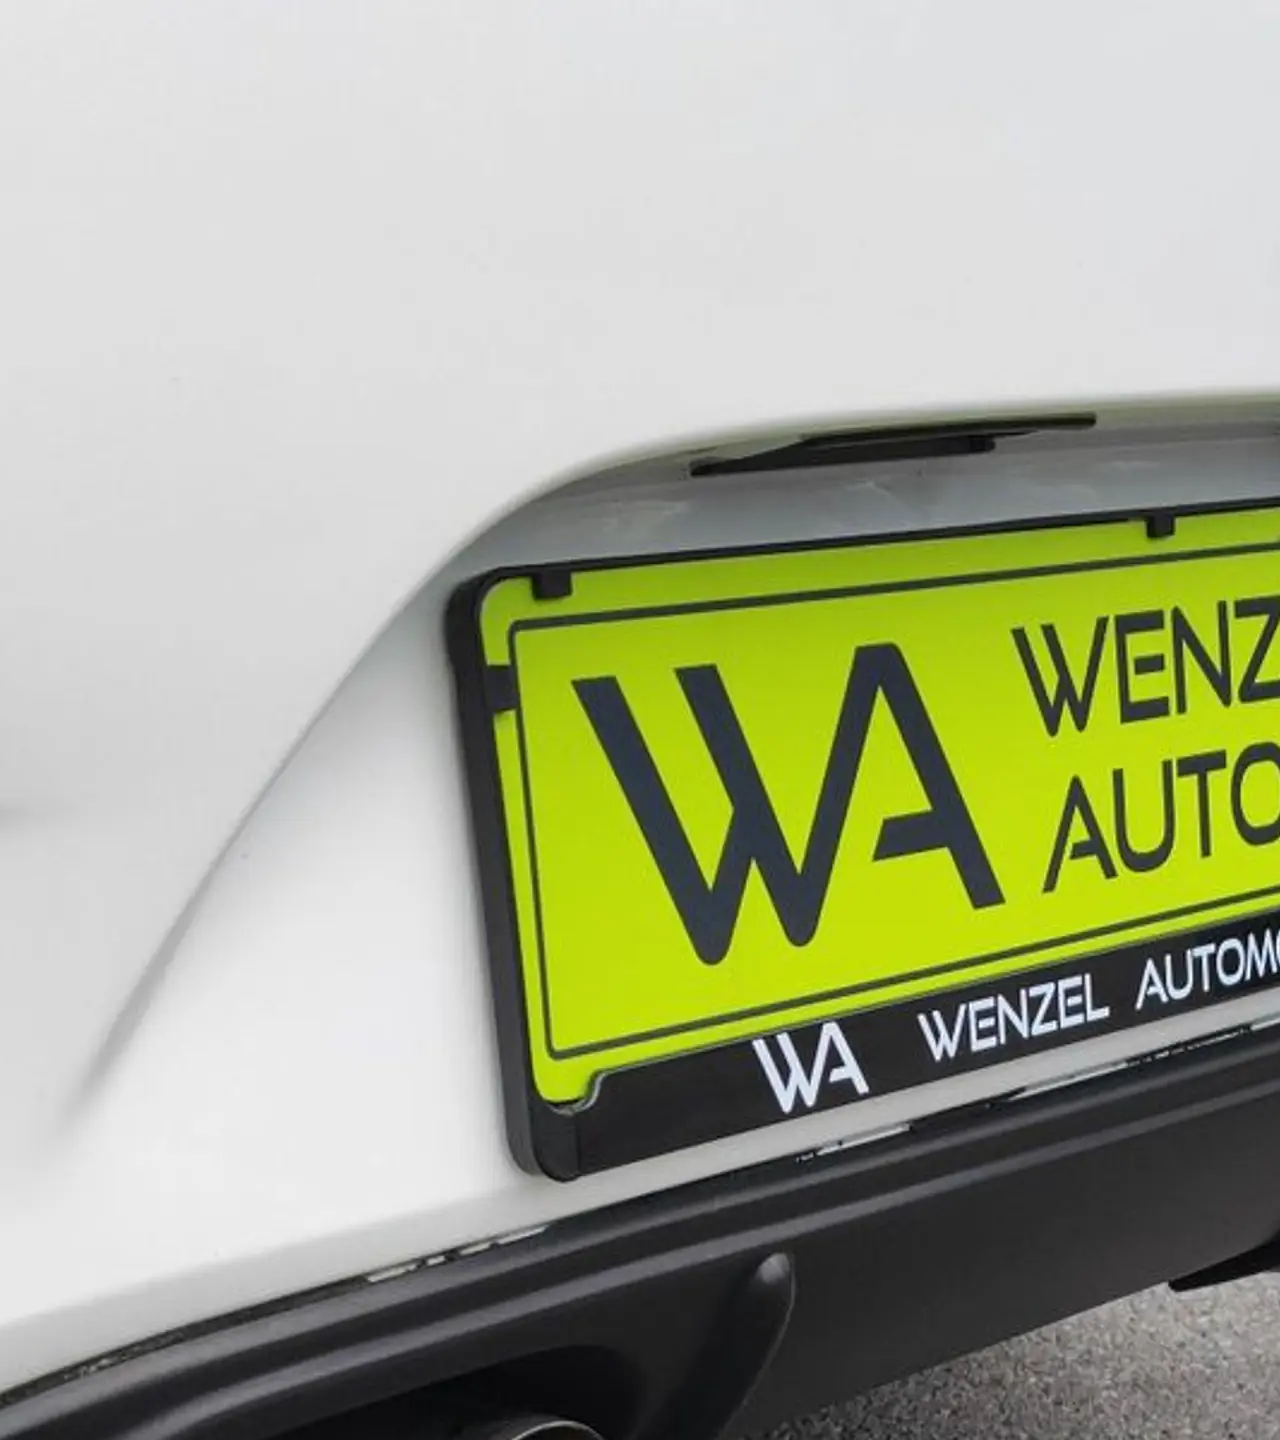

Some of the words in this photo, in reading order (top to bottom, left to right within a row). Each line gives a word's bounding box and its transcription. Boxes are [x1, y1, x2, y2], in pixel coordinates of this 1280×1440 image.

[572, 643, 1005, 966] WA
[752, 1021, 870, 1113] WA
[918, 973, 1110, 1061] WENZEL
